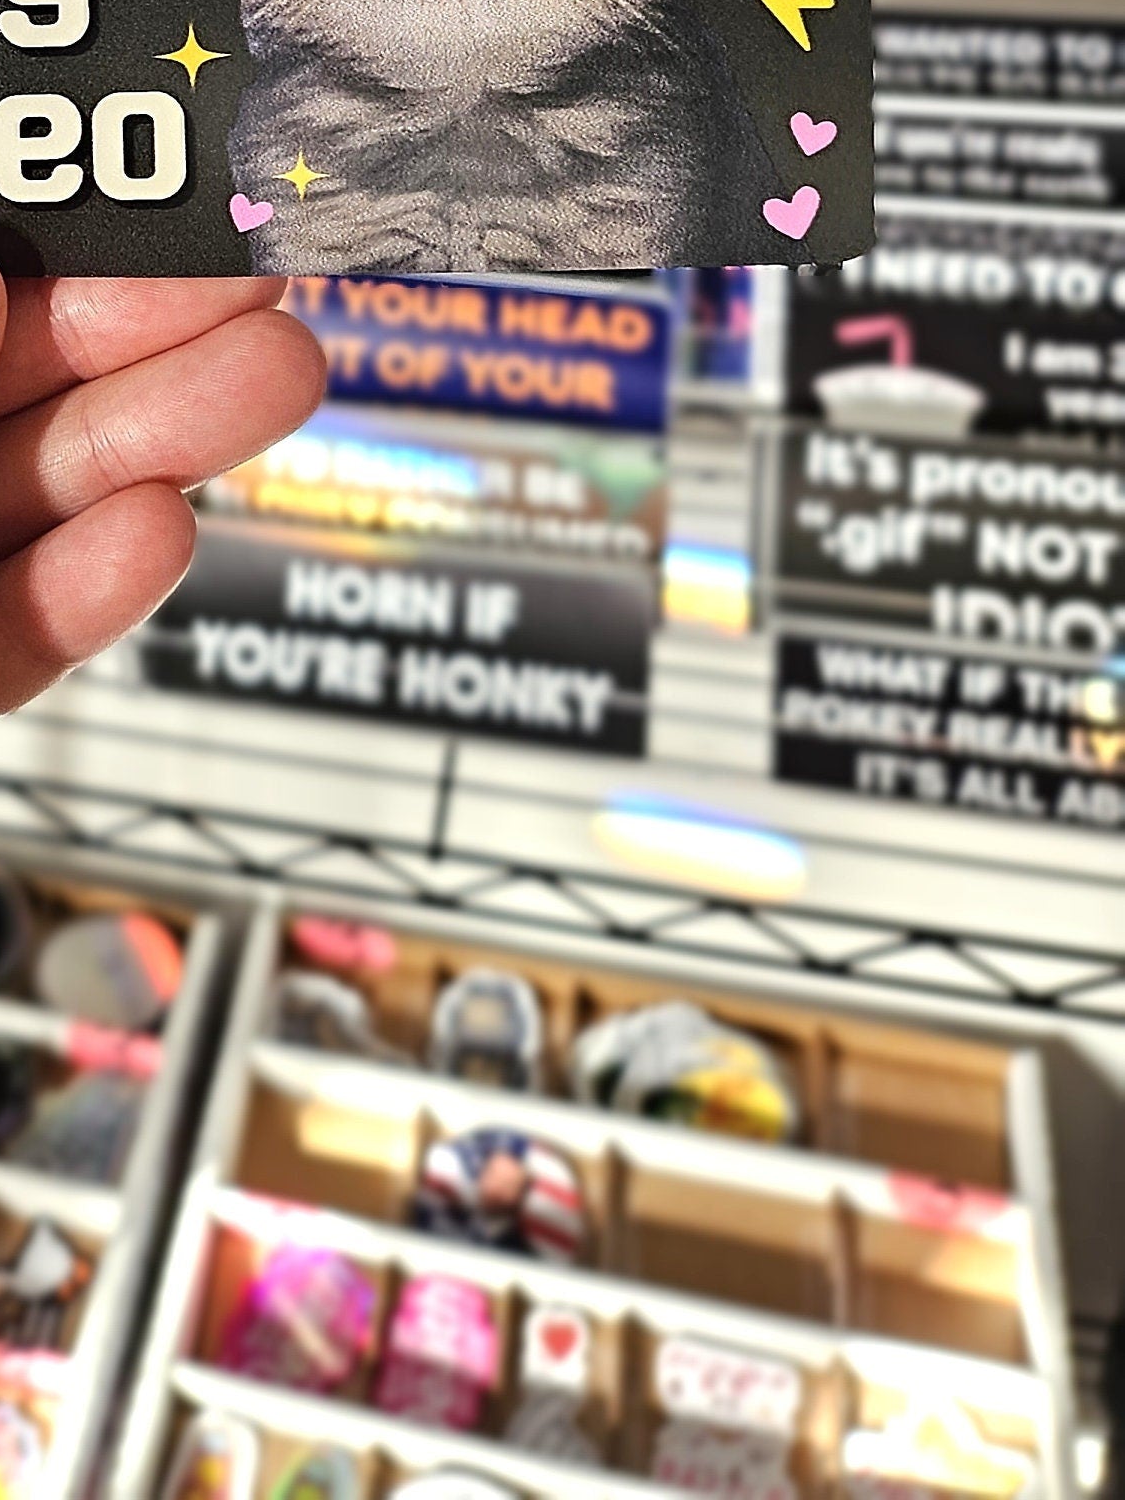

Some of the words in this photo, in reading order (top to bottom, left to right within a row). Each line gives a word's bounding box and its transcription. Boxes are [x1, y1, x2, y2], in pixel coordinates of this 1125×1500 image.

[871, 246, 1016, 301] NEED
[1024, 256, 1104, 312] TO
[338, 279, 486, 335] YOUR
[498, 294, 655, 354] HEAD
[377, 341, 450, 389] OF
[459, 348, 617, 412] YOUR
[805, 433, 901, 491] It's
[977, 520, 1121, 585] NOT
[283, 559, 453, 636] HORN
[466, 583, 521, 643] IF
[931, 584, 1125, 652] IDIO
[190, 619, 385, 701] YOU'RE
[397, 647, 614, 733] HONKY
[815, 642, 952, 698] WHAT
[961, 664, 1007, 703] IF
[854, 753, 948, 800] IT'S
[957, 768, 1043, 815] ALL
